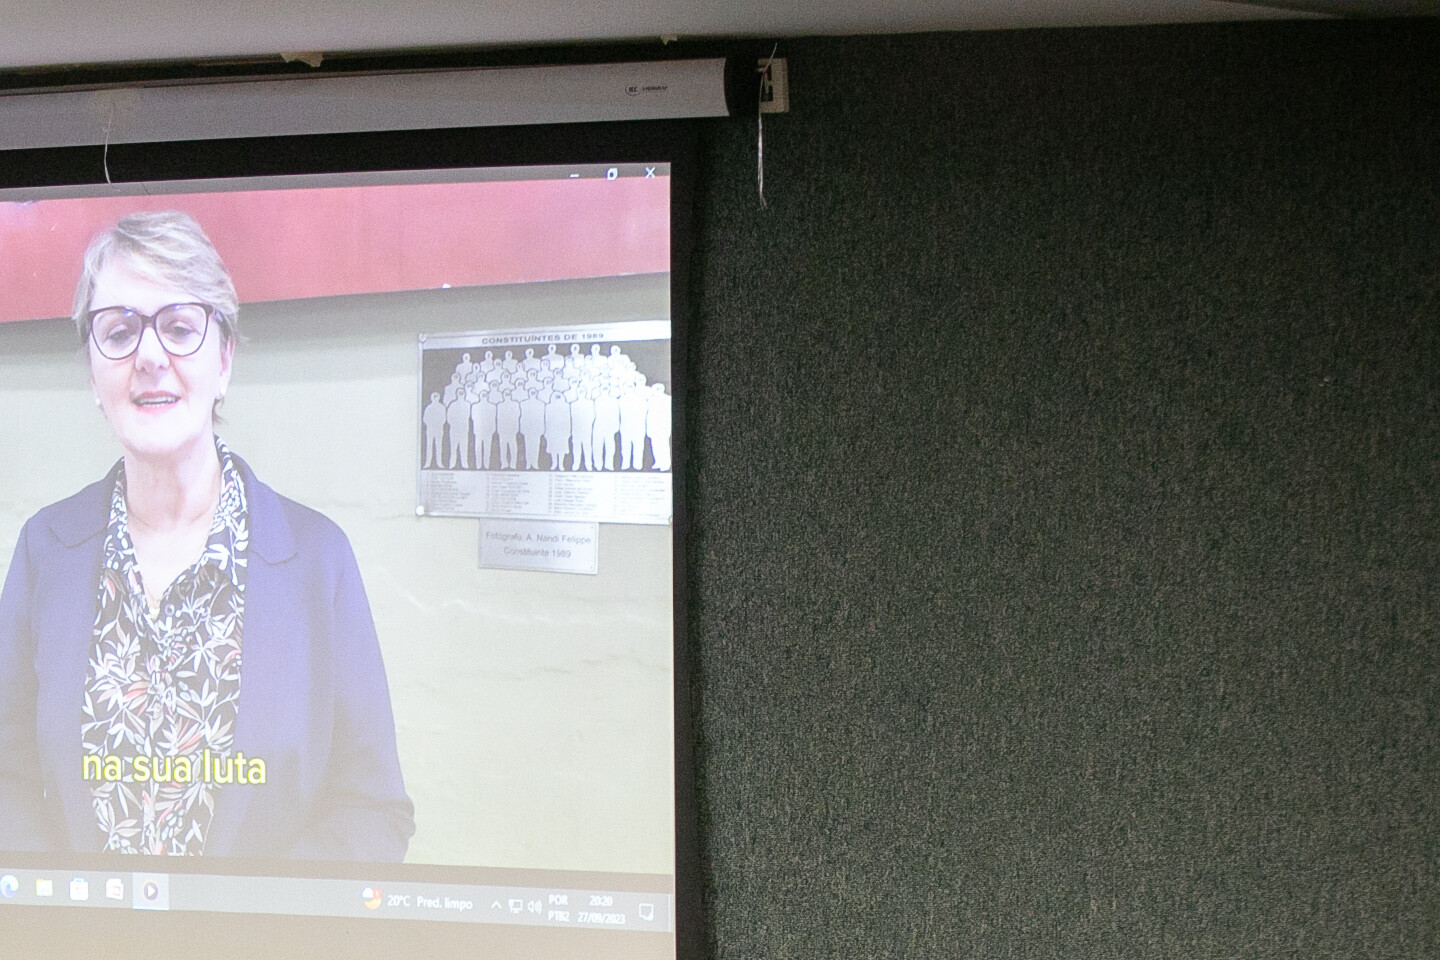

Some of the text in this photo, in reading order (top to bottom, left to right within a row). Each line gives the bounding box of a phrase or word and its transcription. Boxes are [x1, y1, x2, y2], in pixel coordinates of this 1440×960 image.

[563, 333, 578, 341] DE
[552, 549, 572, 558] 1989
[82, 749, 266, 784] na sua luta
[416, 895, 442, 909] Pred.
[445, 896, 474, 912] limpo
[548, 894, 569, 906] POR
[577, 911, 626, 925] 27/09/2023
